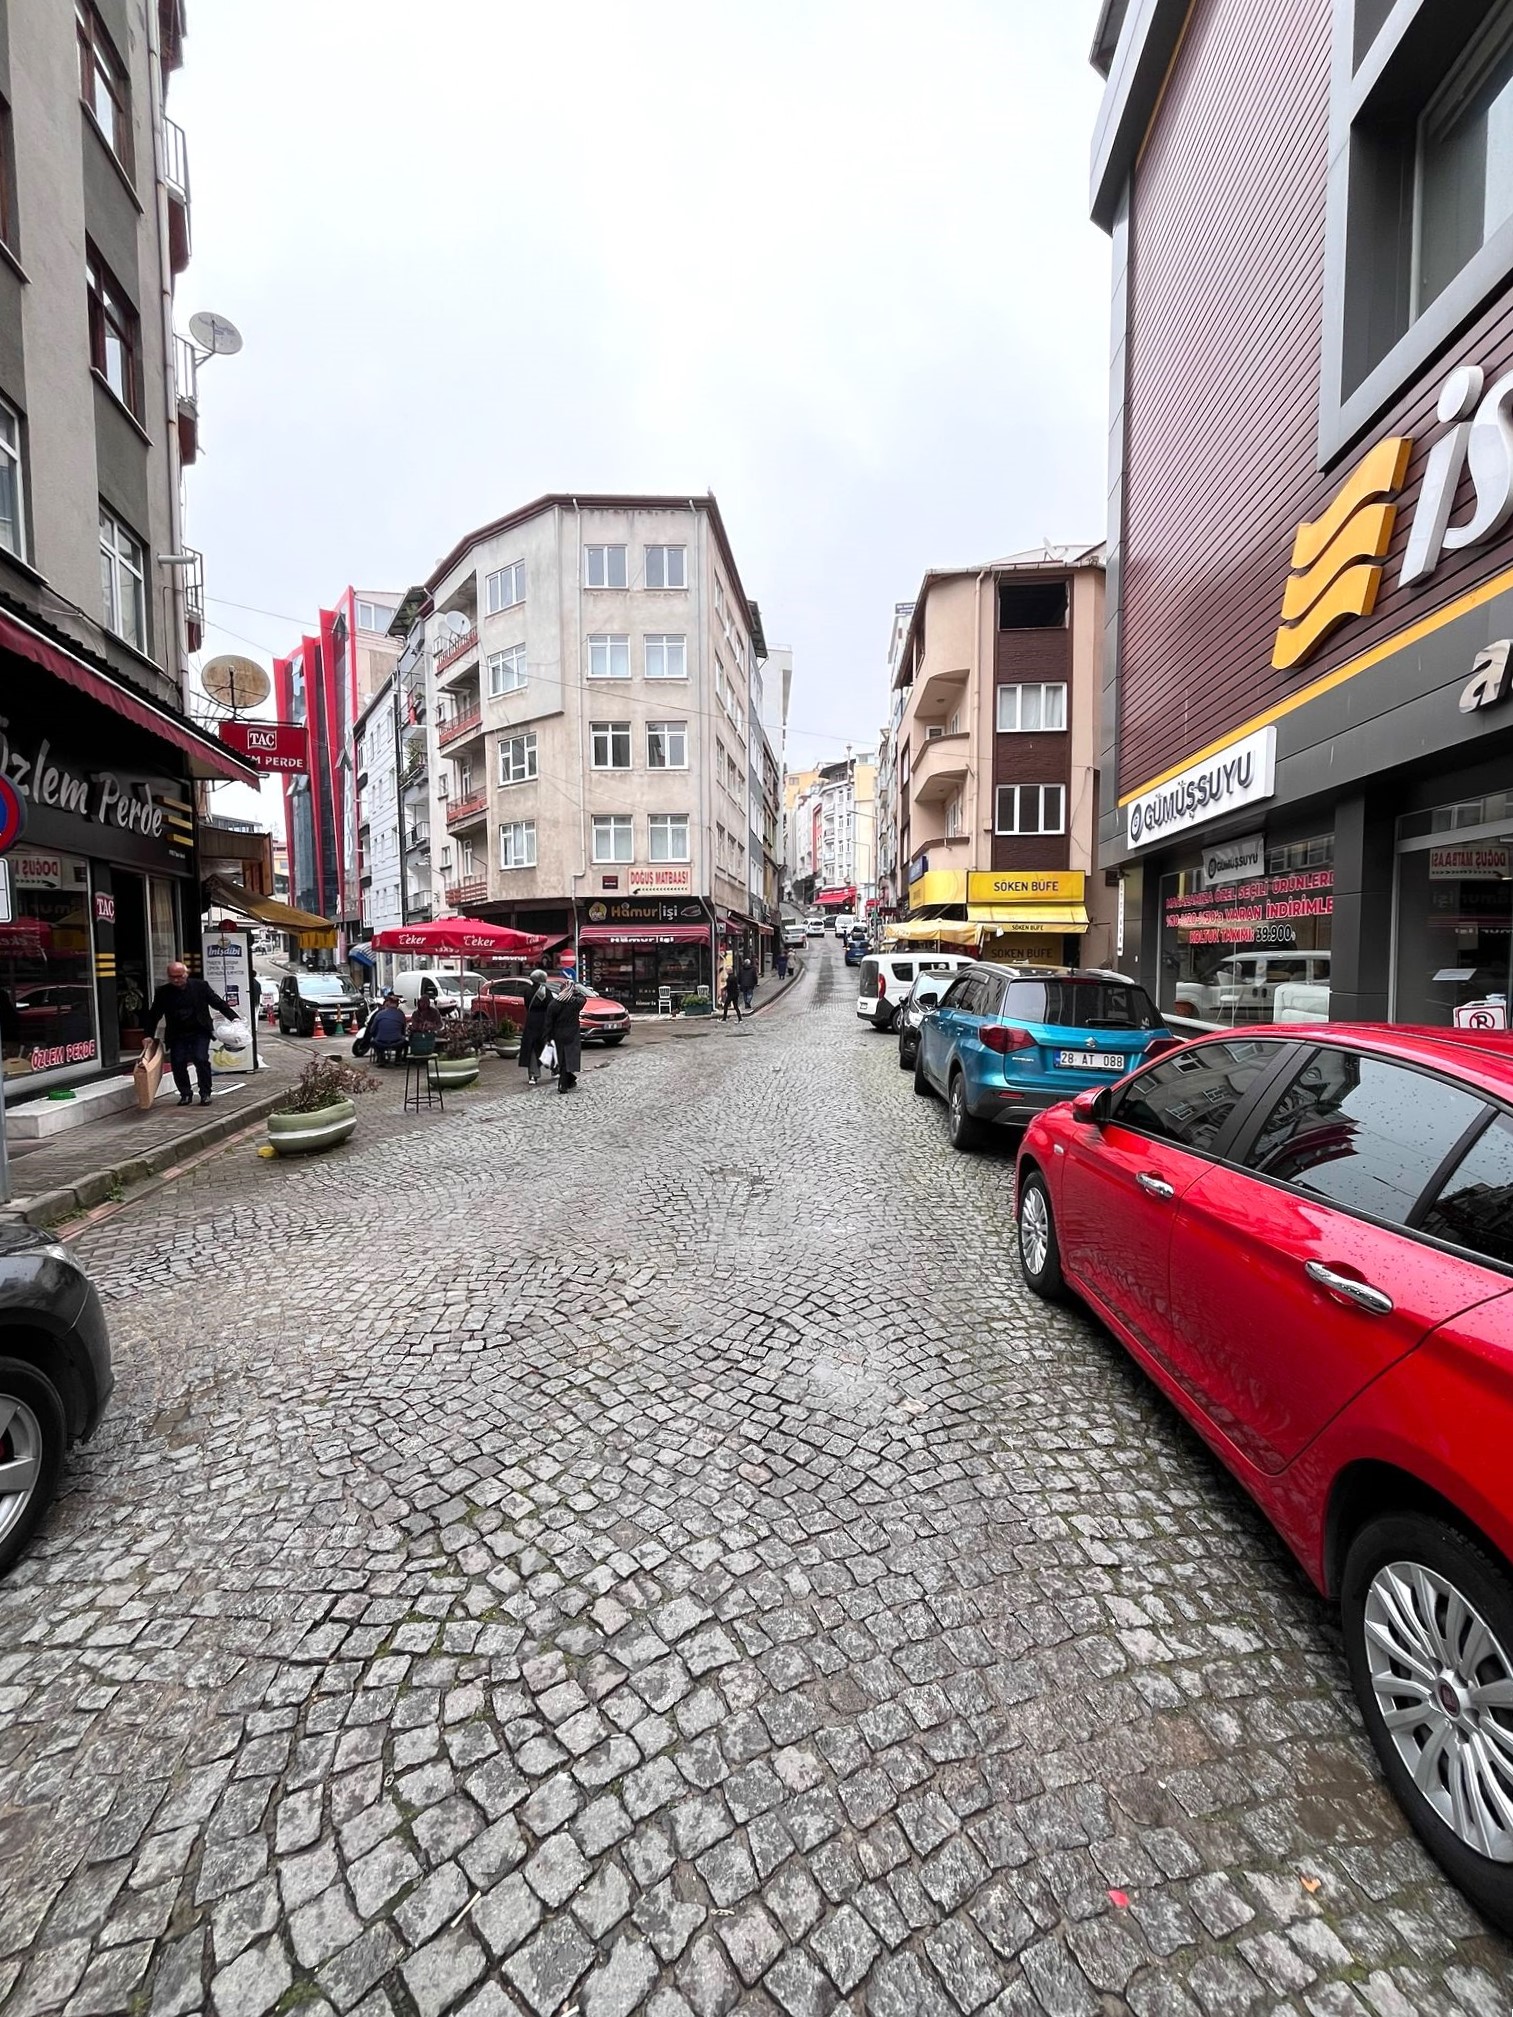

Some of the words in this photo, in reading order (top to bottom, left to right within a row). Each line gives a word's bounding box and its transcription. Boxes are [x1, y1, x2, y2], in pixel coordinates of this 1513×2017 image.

[249, 732, 275, 748] TAÇ
[265, 756, 304, 768] PERDE
[1144, 750, 1253, 831] GÜMÜŞSUYU
[91, 771, 163, 838] Perde
[1217, 852, 1259, 872] GÜMÜŞSUYU
[630, 869, 654, 887] DOĞUŞ
[655, 870, 689, 885] MATBAASI
[993, 879, 1029, 892] SÖKEN
[1031, 878, 1059, 892] BÜFE
[1214, 885, 1237, 903] ÖZEL
[97, 898, 115, 919] TAÇ
[1225, 904, 1263, 923] VARAN
[32, 1046, 65, 1071] ÖZLEM
[66, 1039, 95, 1063] PERDE
[1061, 1052, 1075, 1065] 28
[1081, 1053, 1096, 1066] AT
[1103, 1055, 1124, 1068] 088
